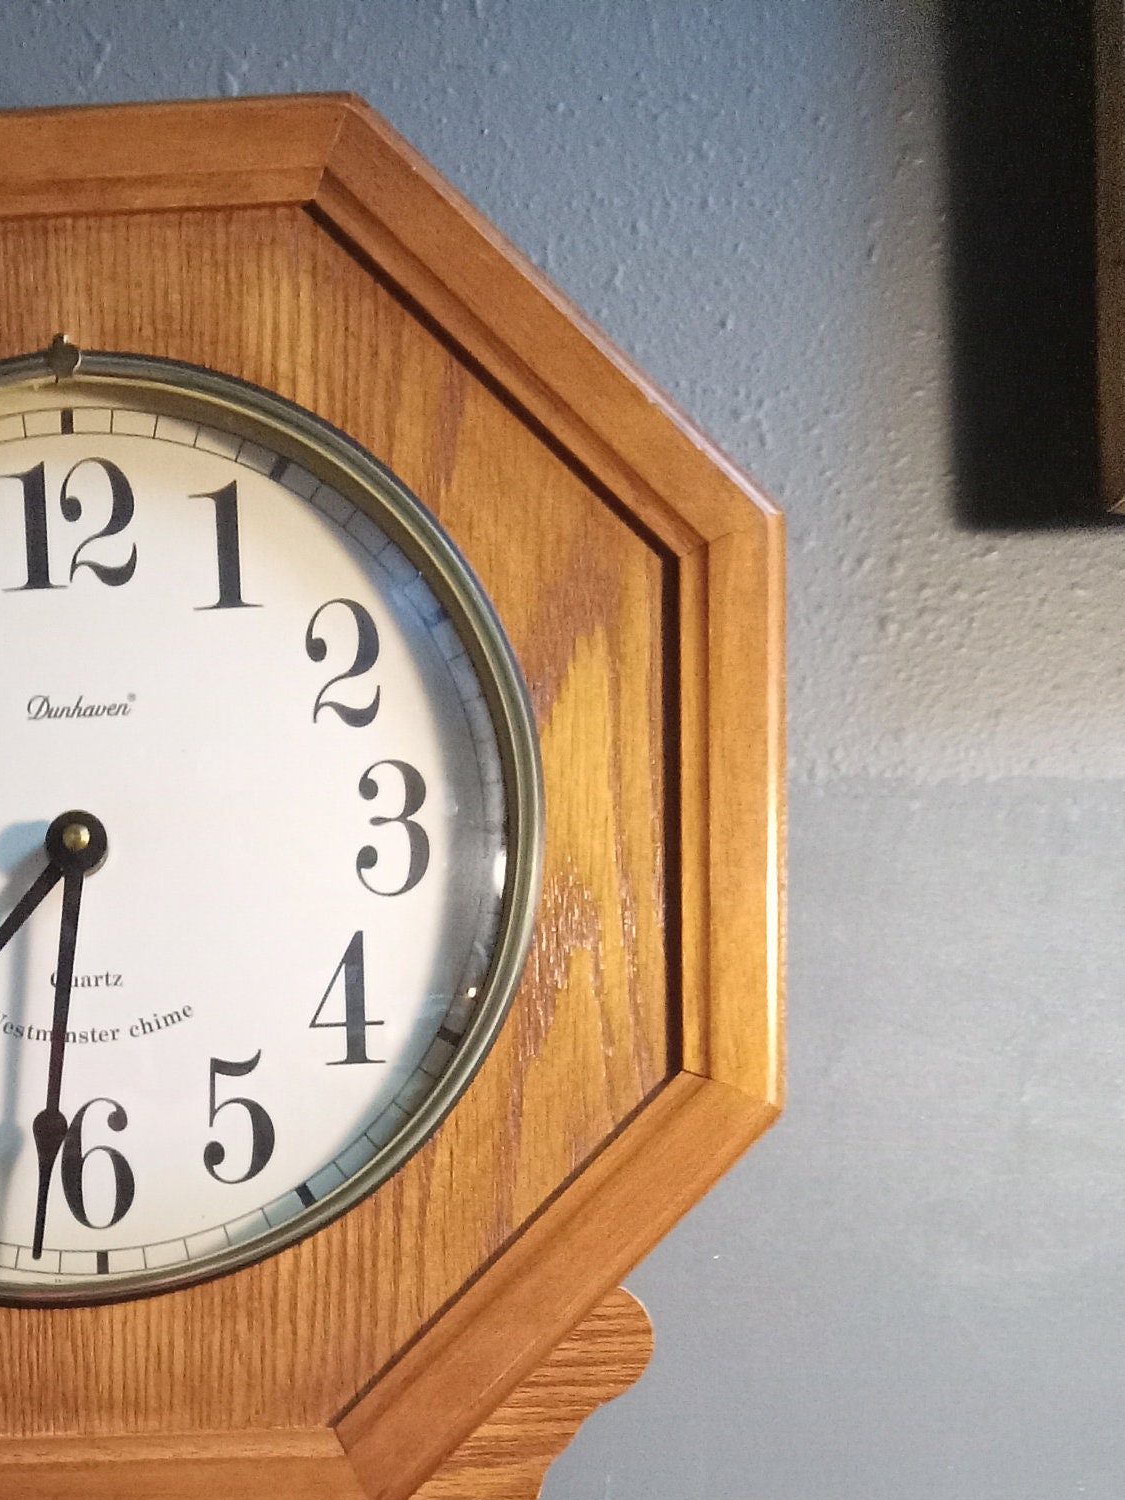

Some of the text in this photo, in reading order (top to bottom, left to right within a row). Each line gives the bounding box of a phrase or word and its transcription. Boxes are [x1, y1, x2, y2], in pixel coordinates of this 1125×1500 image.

[188, 479, 266, 612] 1
[304, 598, 383, 728] 2
[355, 759, 431, 897] 3
[128, 1003, 194, 1039] chime
[308, 930, 387, 1067] 4
[61, 1097, 136, 1230] 6
[202, 1048, 277, 1185] 5
